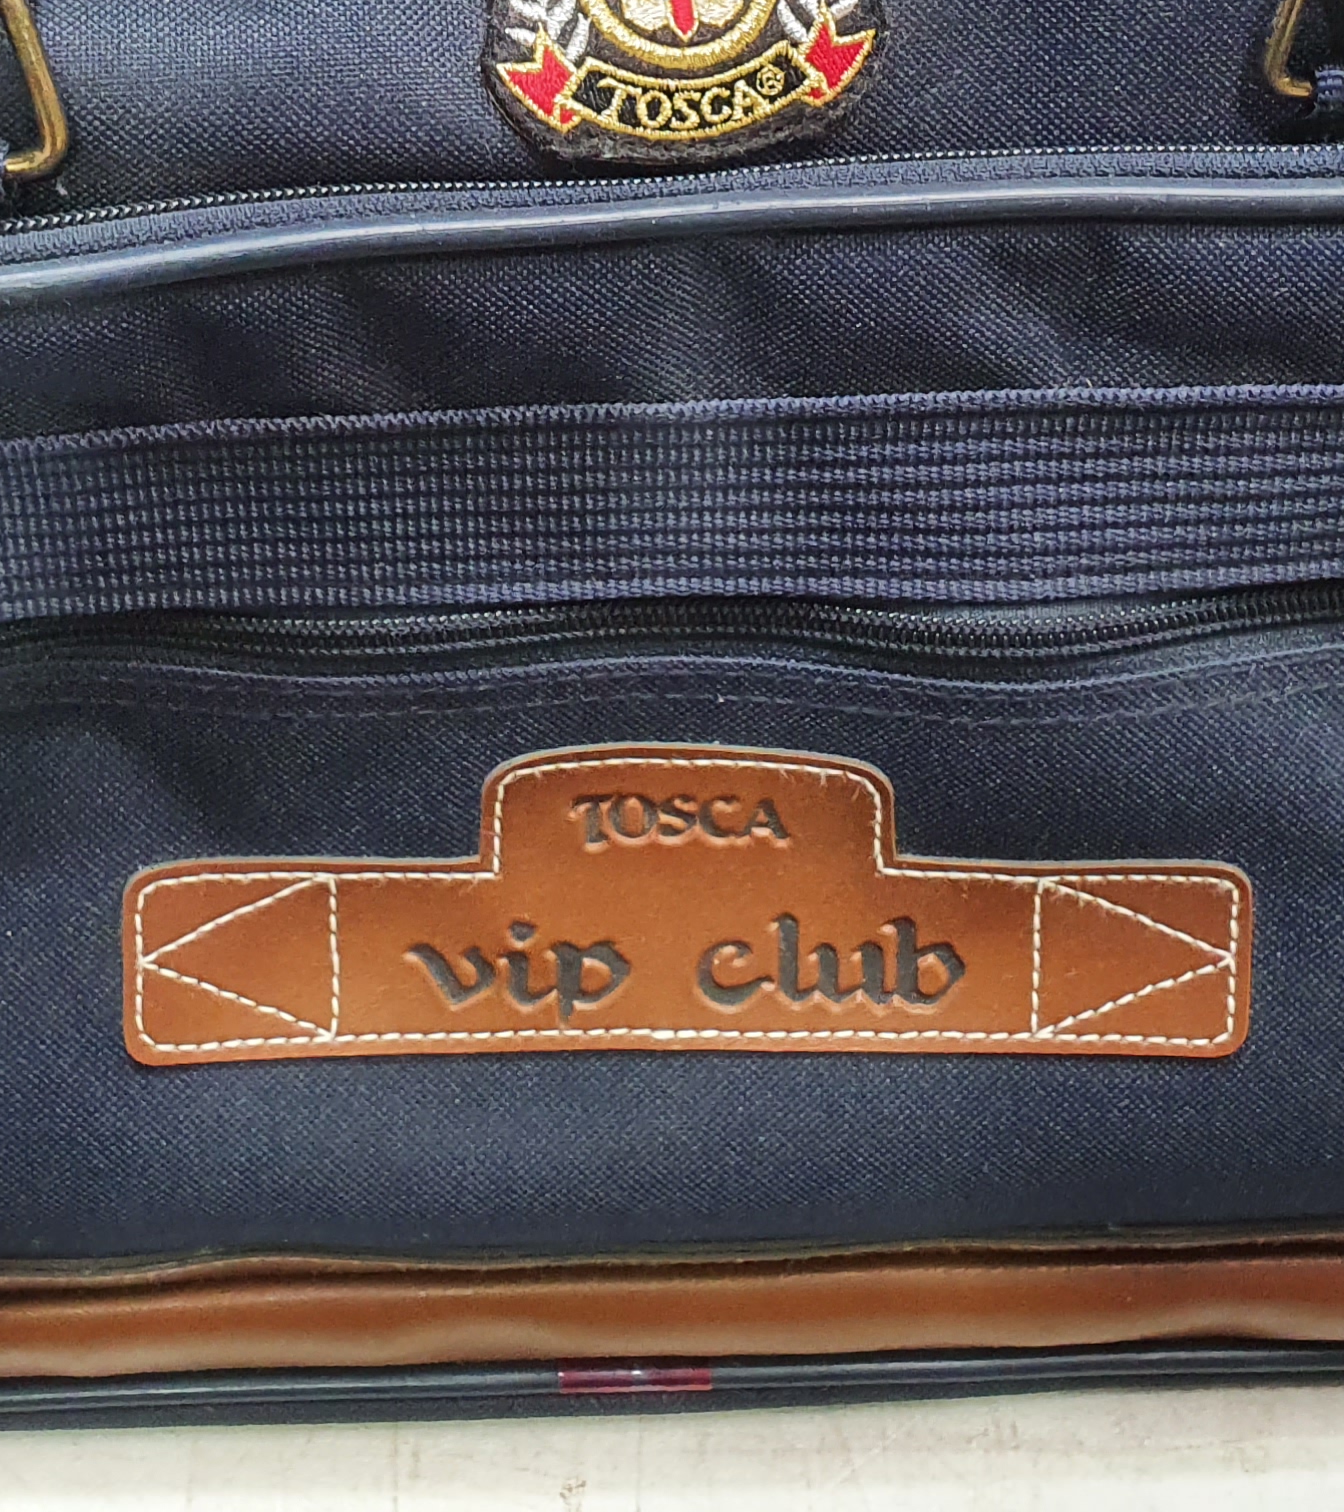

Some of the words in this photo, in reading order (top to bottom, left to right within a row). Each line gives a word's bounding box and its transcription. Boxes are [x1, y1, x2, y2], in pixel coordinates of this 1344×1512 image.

[566, 792, 792, 848] TOSCA
[403, 919, 633, 1025] vip
[696, 912, 968, 1010] club
